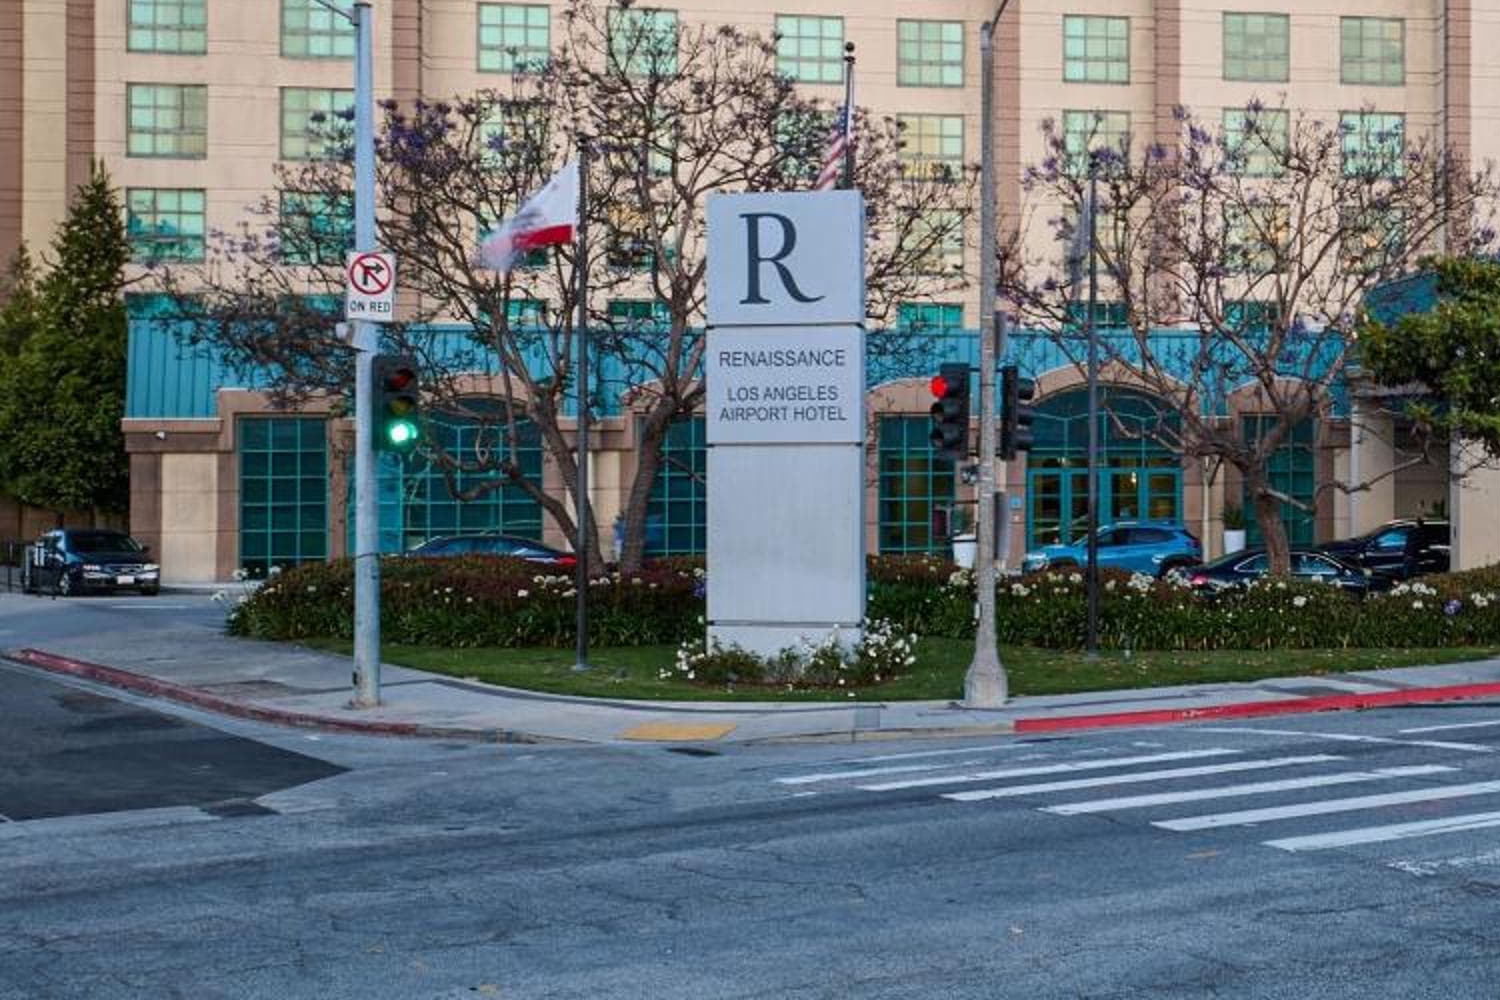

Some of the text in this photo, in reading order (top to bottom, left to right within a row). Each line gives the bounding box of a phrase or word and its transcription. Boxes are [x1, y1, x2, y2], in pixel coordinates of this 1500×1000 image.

[738, 212, 827, 305] R
[350, 300, 390, 312] ON RED
[718, 349, 846, 368] RENAISSANCE
[727, 385, 839, 402] LOS ANGELES
[719, 405, 847, 422] AIRPORT HOTEL
